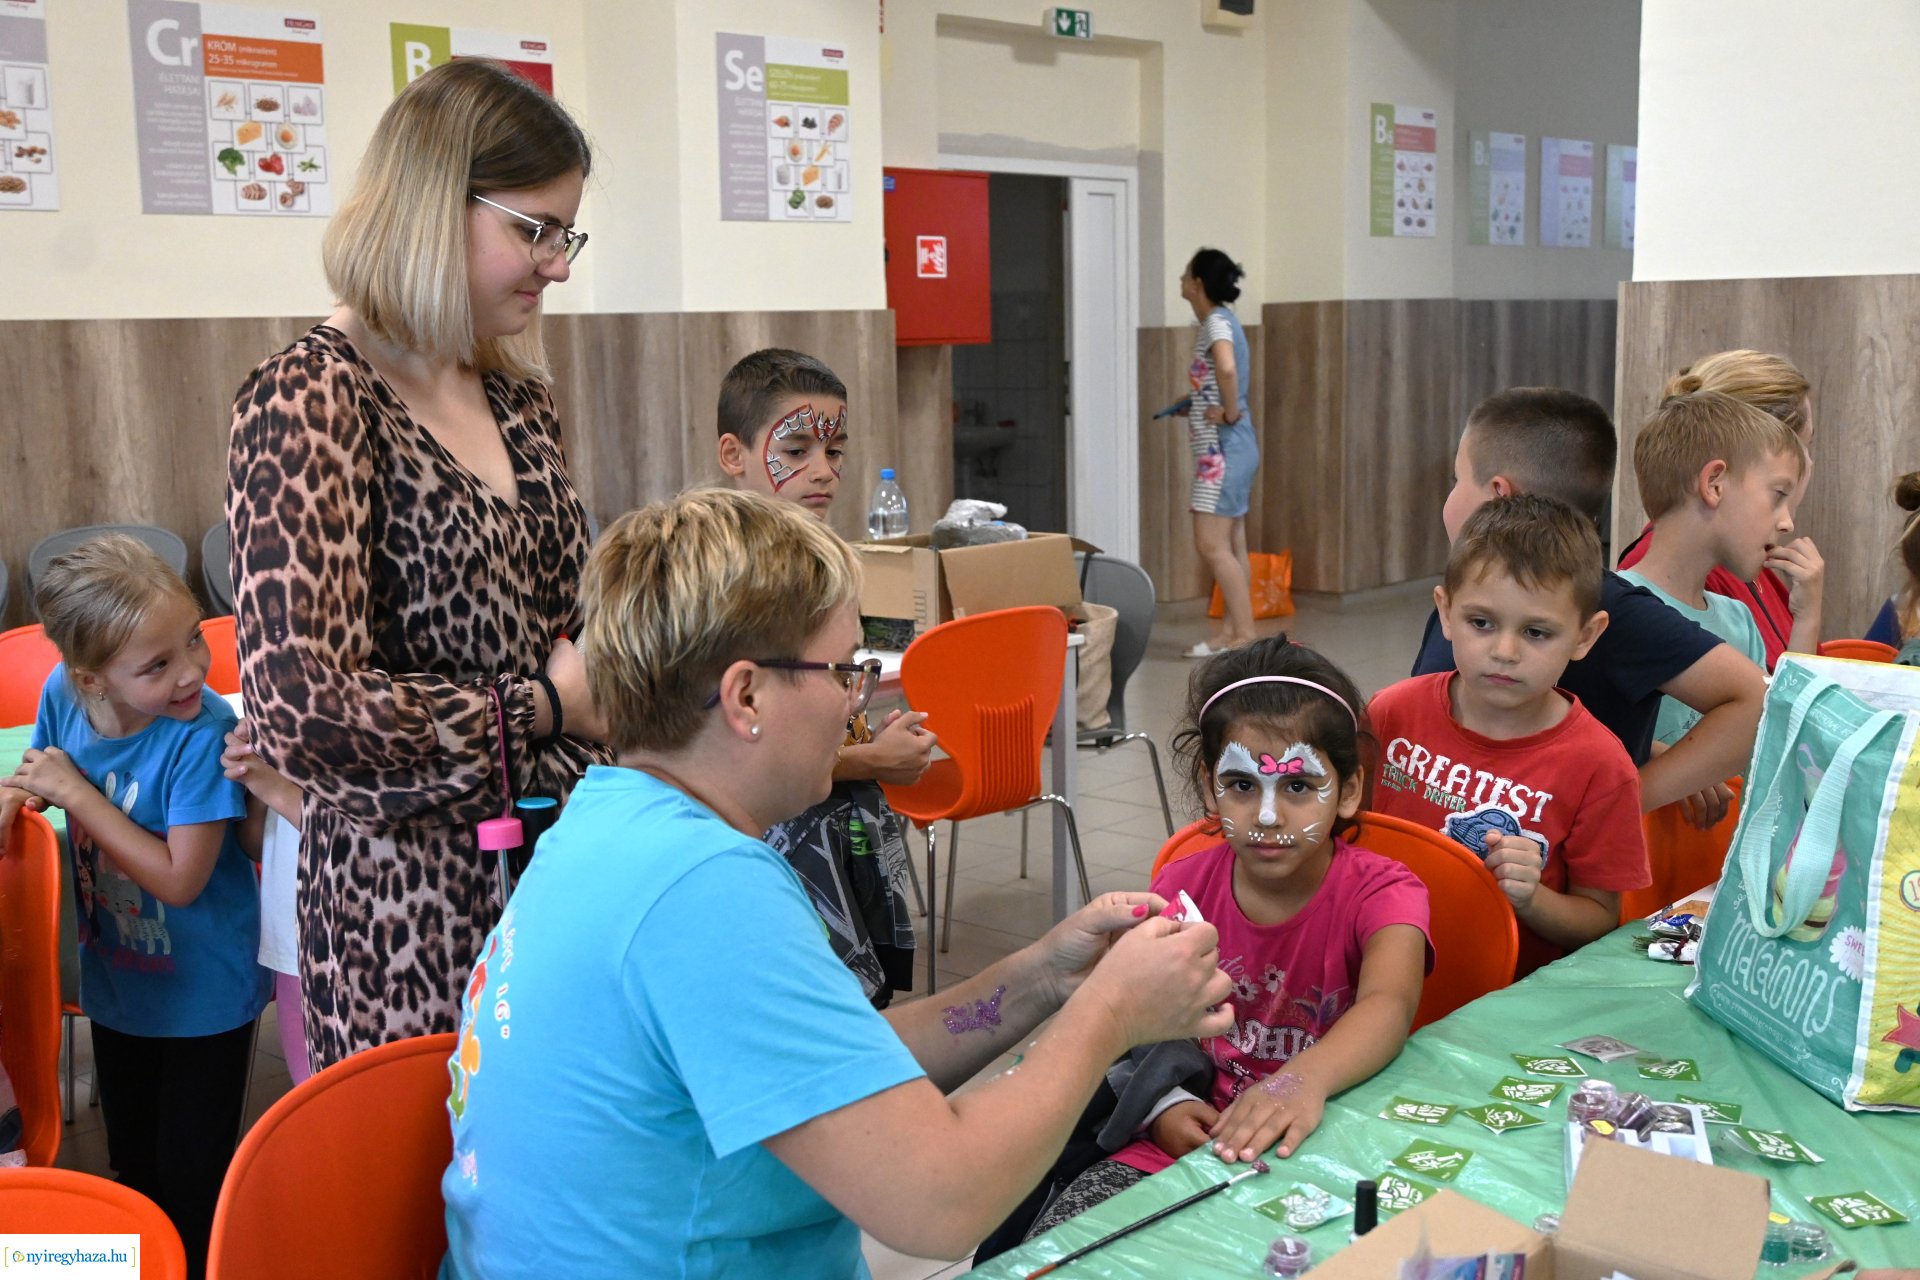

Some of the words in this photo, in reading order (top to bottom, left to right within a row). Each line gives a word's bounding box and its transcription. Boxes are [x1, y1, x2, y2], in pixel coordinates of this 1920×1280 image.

[147, 18, 199, 67] Cr
[725, 50, 763, 92] Se
[1383, 763, 1417, 793] TRUCK
[1423, 785, 1467, 813] DRIVER
[1386, 737, 1553, 822] GREATEST
